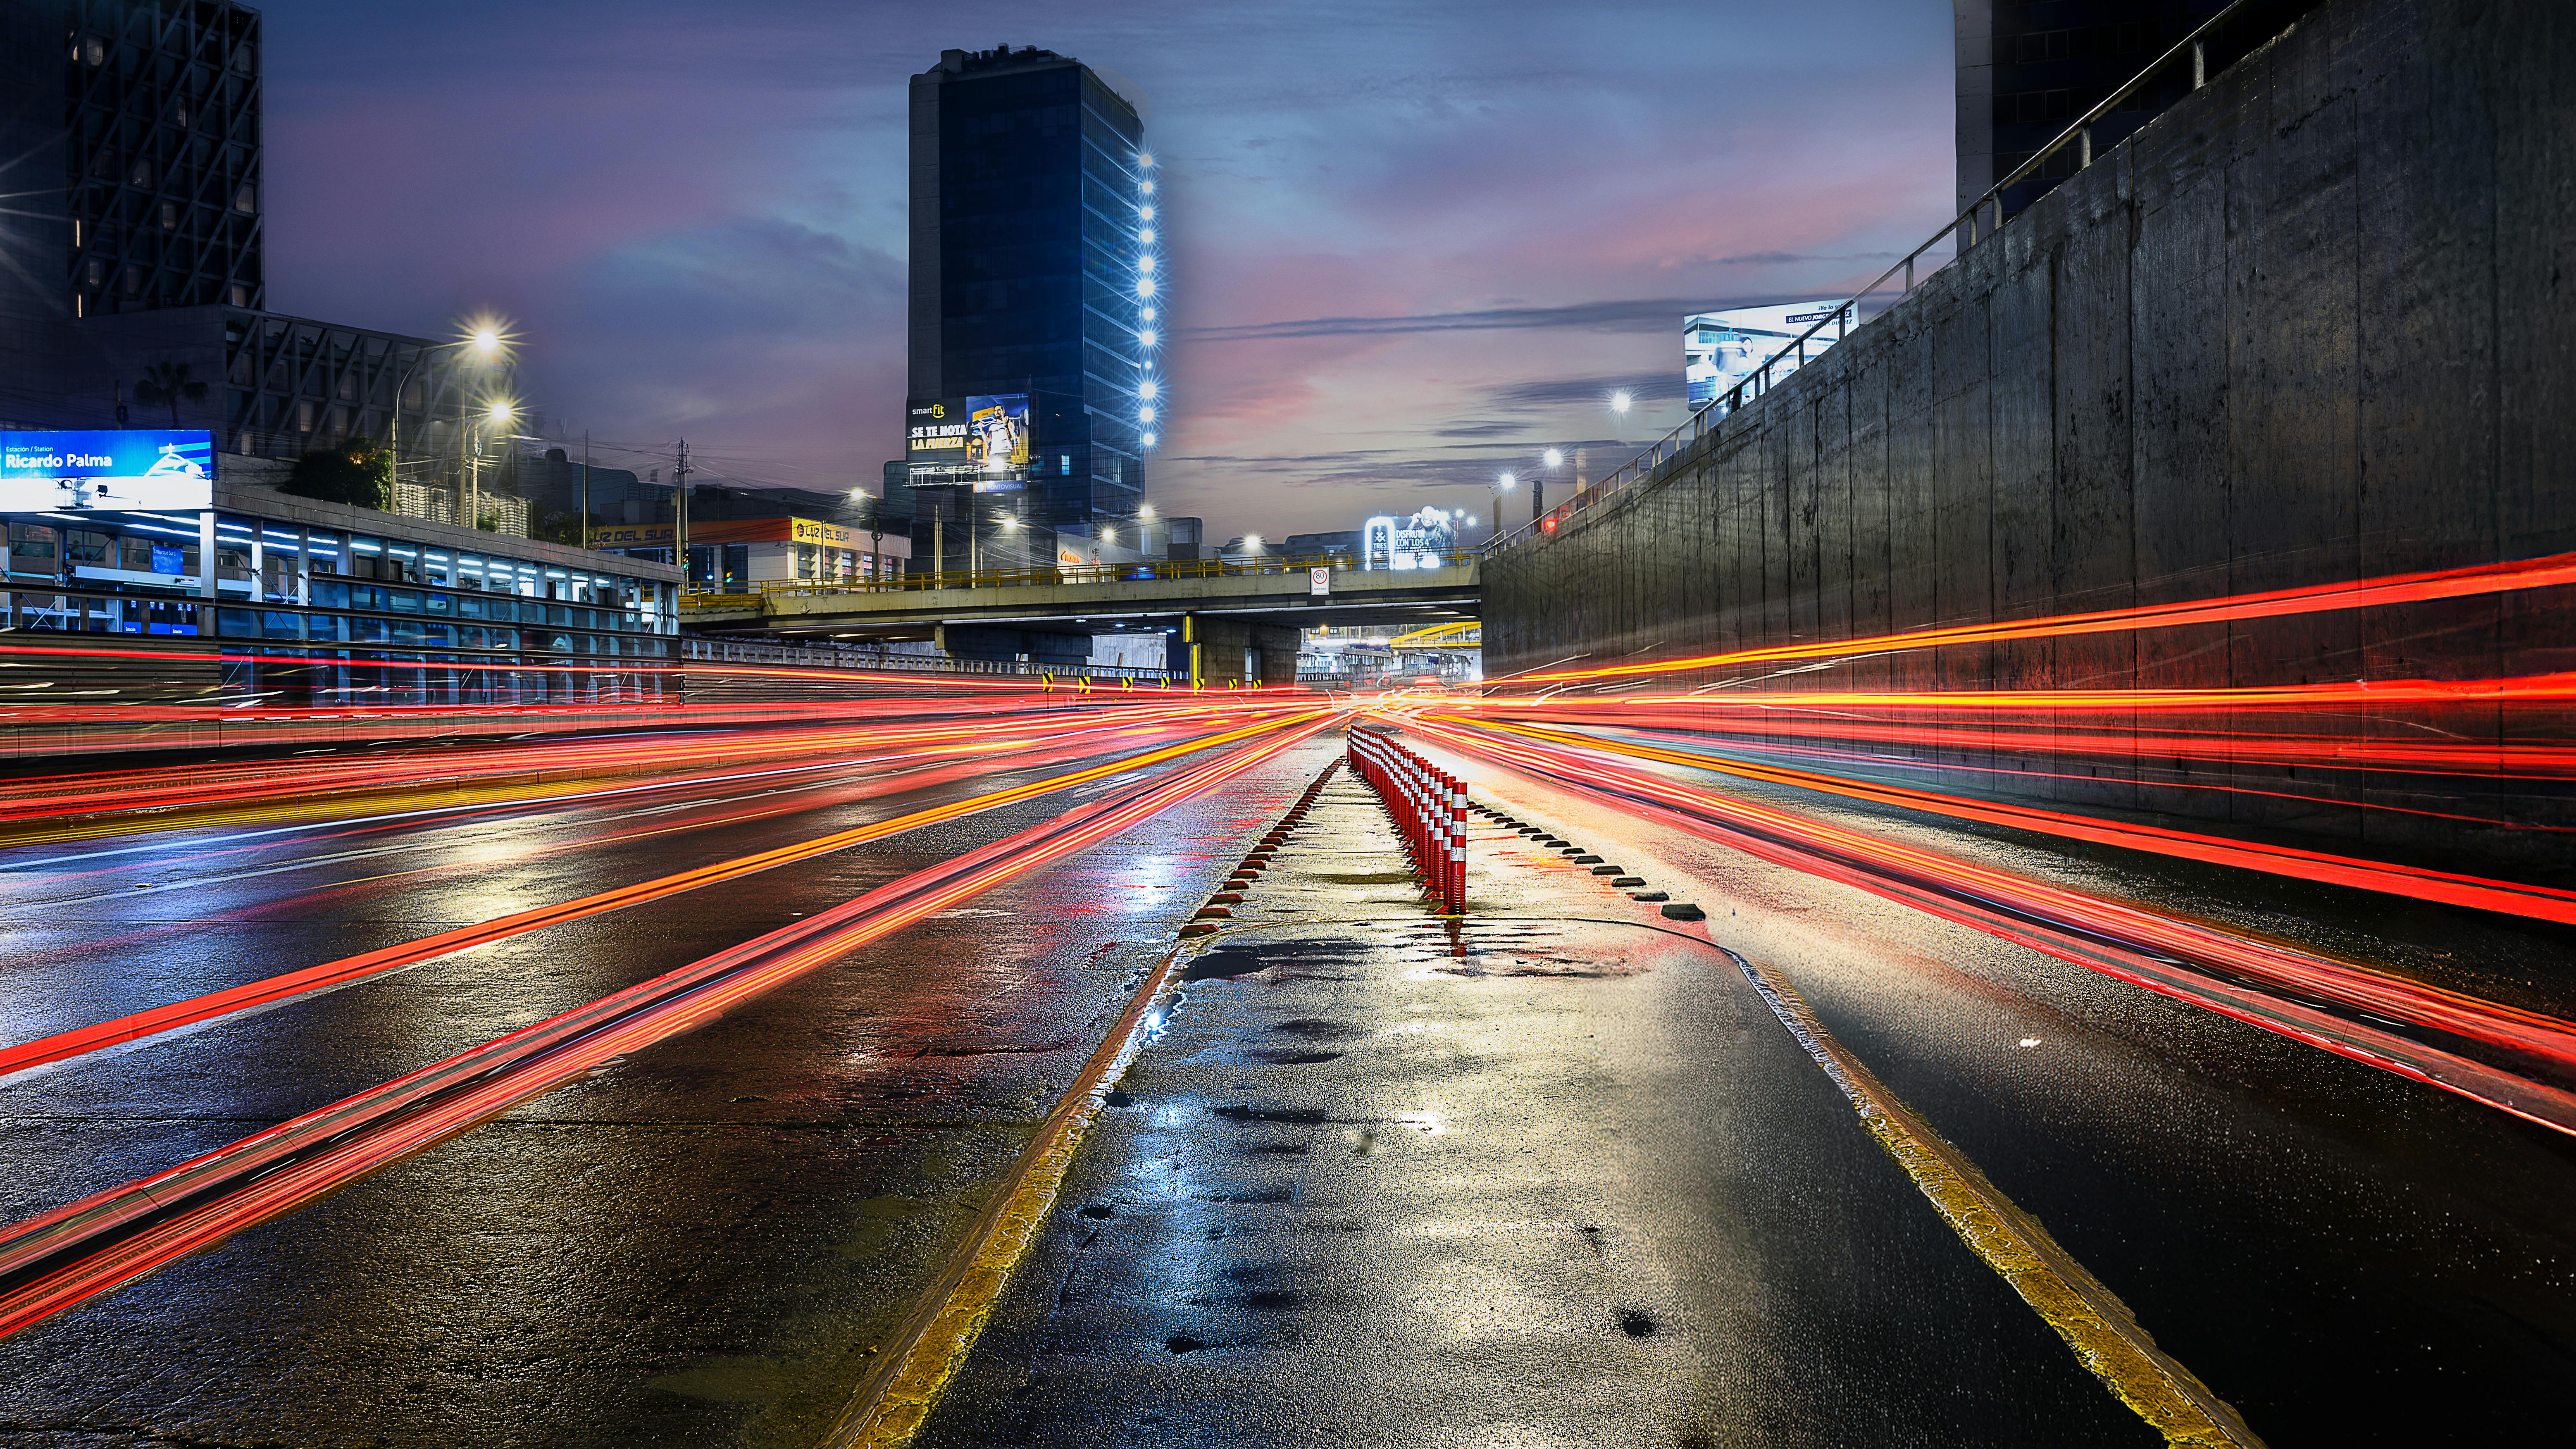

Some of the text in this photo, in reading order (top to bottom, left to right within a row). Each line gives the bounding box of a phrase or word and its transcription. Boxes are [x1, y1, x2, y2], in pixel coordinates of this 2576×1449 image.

[933, 404, 944, 415] fit
[912, 424, 967, 438] SE TE NOTA
[912, 436, 963, 450] LA FUERZA
[6, 453, 112, 468] Ricardo Palma
[589, 529, 674, 542] UZ DEL SUR
[806, 526, 820, 538] LUZ
[835, 530, 849, 542] SUR
[1396, 529, 1425, 539] DISFRUTA
[1396, 539, 1409, 547] CON
[1066, 554, 1080, 563] HONDA
